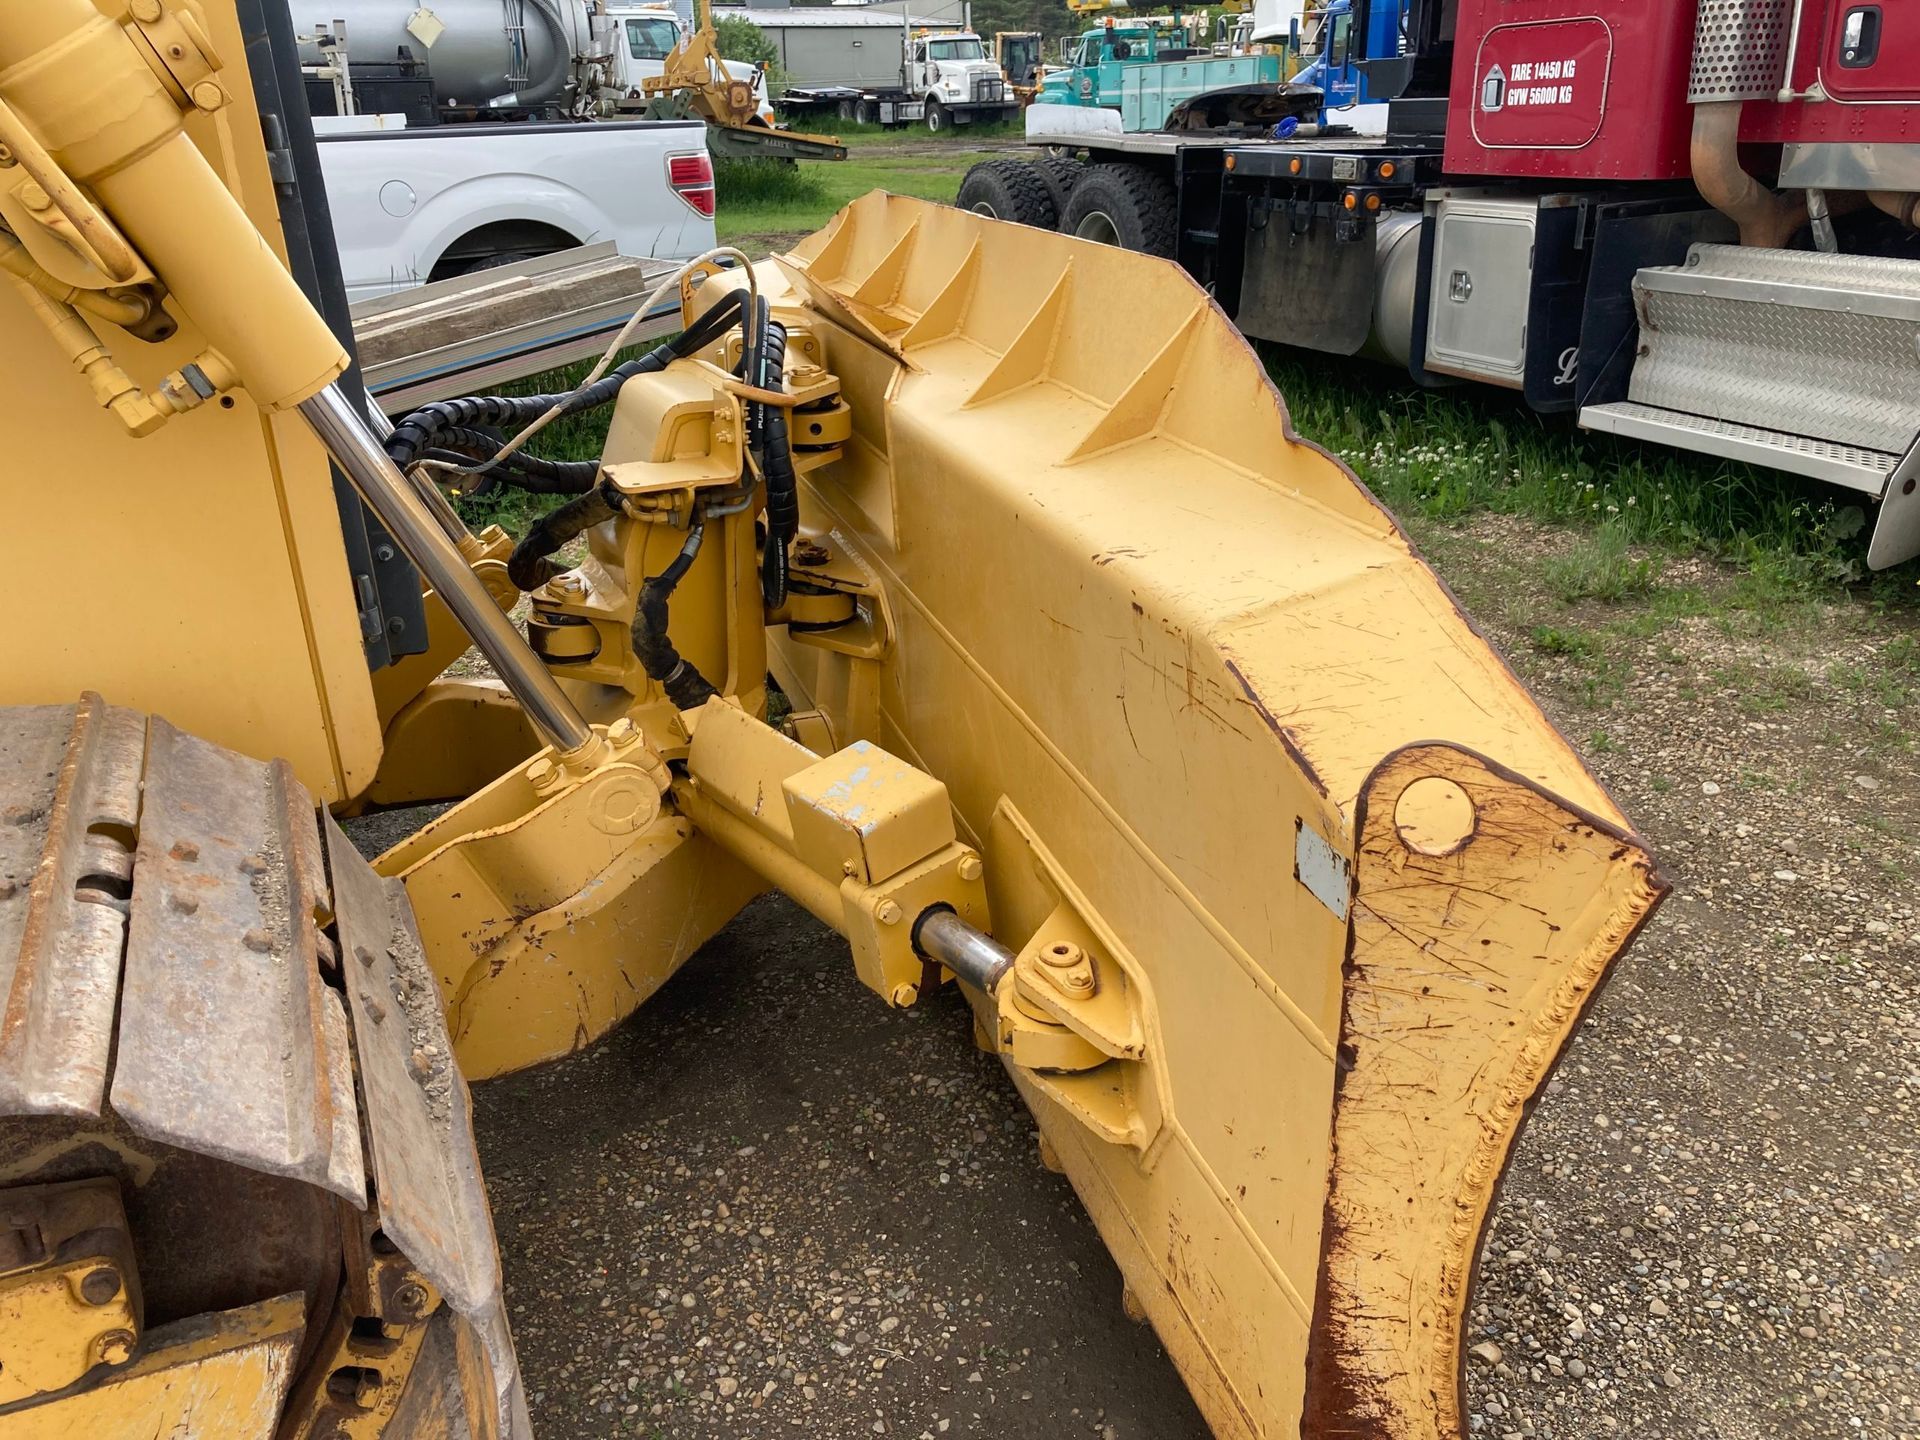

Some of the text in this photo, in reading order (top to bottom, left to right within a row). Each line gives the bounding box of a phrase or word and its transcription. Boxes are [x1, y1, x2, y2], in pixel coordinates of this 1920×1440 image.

[1511, 60, 1575, 81] TARE 14450 KG
[1507, 86, 1572, 105] GVW 56000 KG
